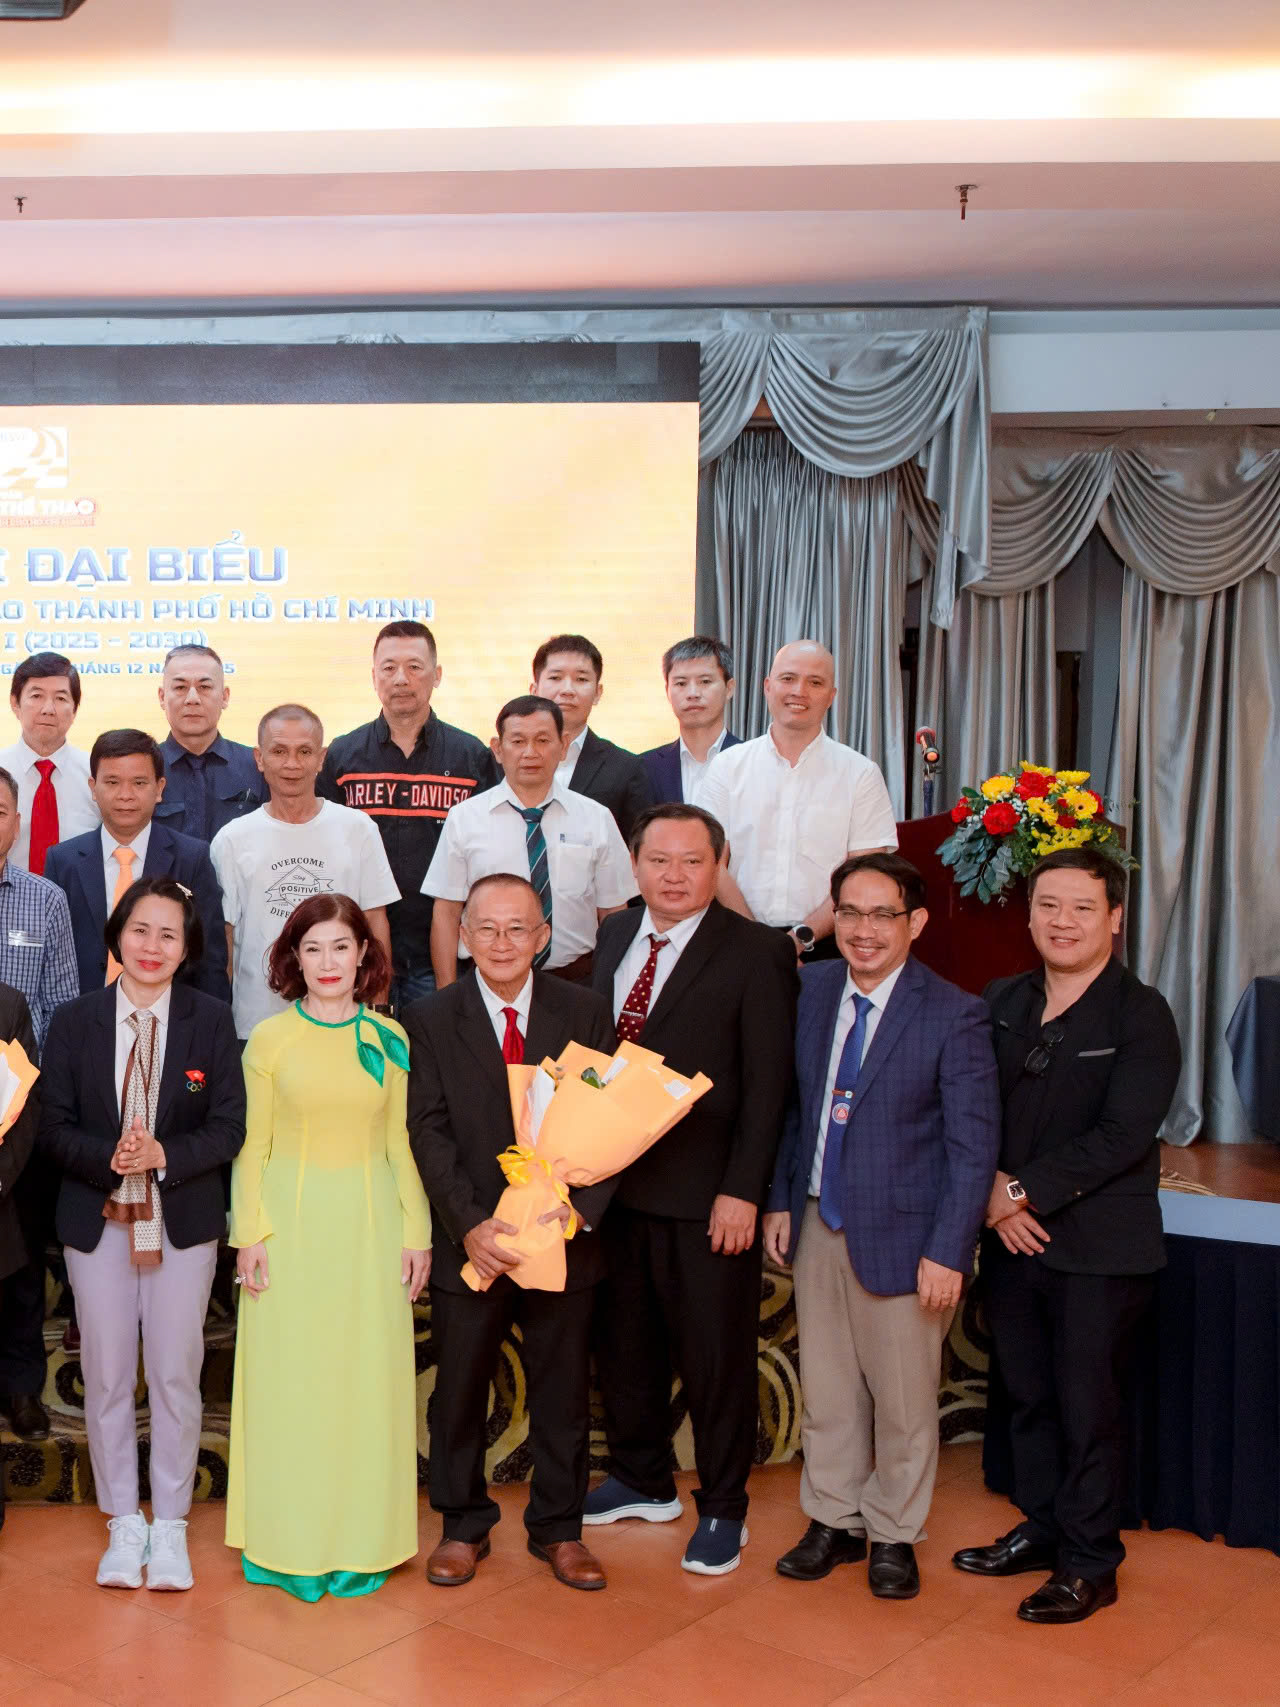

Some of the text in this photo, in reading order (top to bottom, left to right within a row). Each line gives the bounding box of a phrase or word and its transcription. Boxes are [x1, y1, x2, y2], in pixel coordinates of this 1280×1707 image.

[23, 548, 129, 588] ĐẠI
[148, 531, 288, 582] BIỂU
[34, 597, 142, 619] THÀNH
[152, 593, 224, 619] PHỐ
[229, 592, 273, 619] HỒ
[283, 596, 339, 619] CHÍ
[348, 599, 433, 619] MINH
[4, 632, 17, 649] I
[24, 631, 99, 653] (2025
[128, 629, 208, 649] 2030)
[71, 660, 120, 674] HÁNG
[127, 663, 144, 674] 12
[271, 857, 325, 871] OVERCOME
[280, 885, 319, 894] POSITIVE
